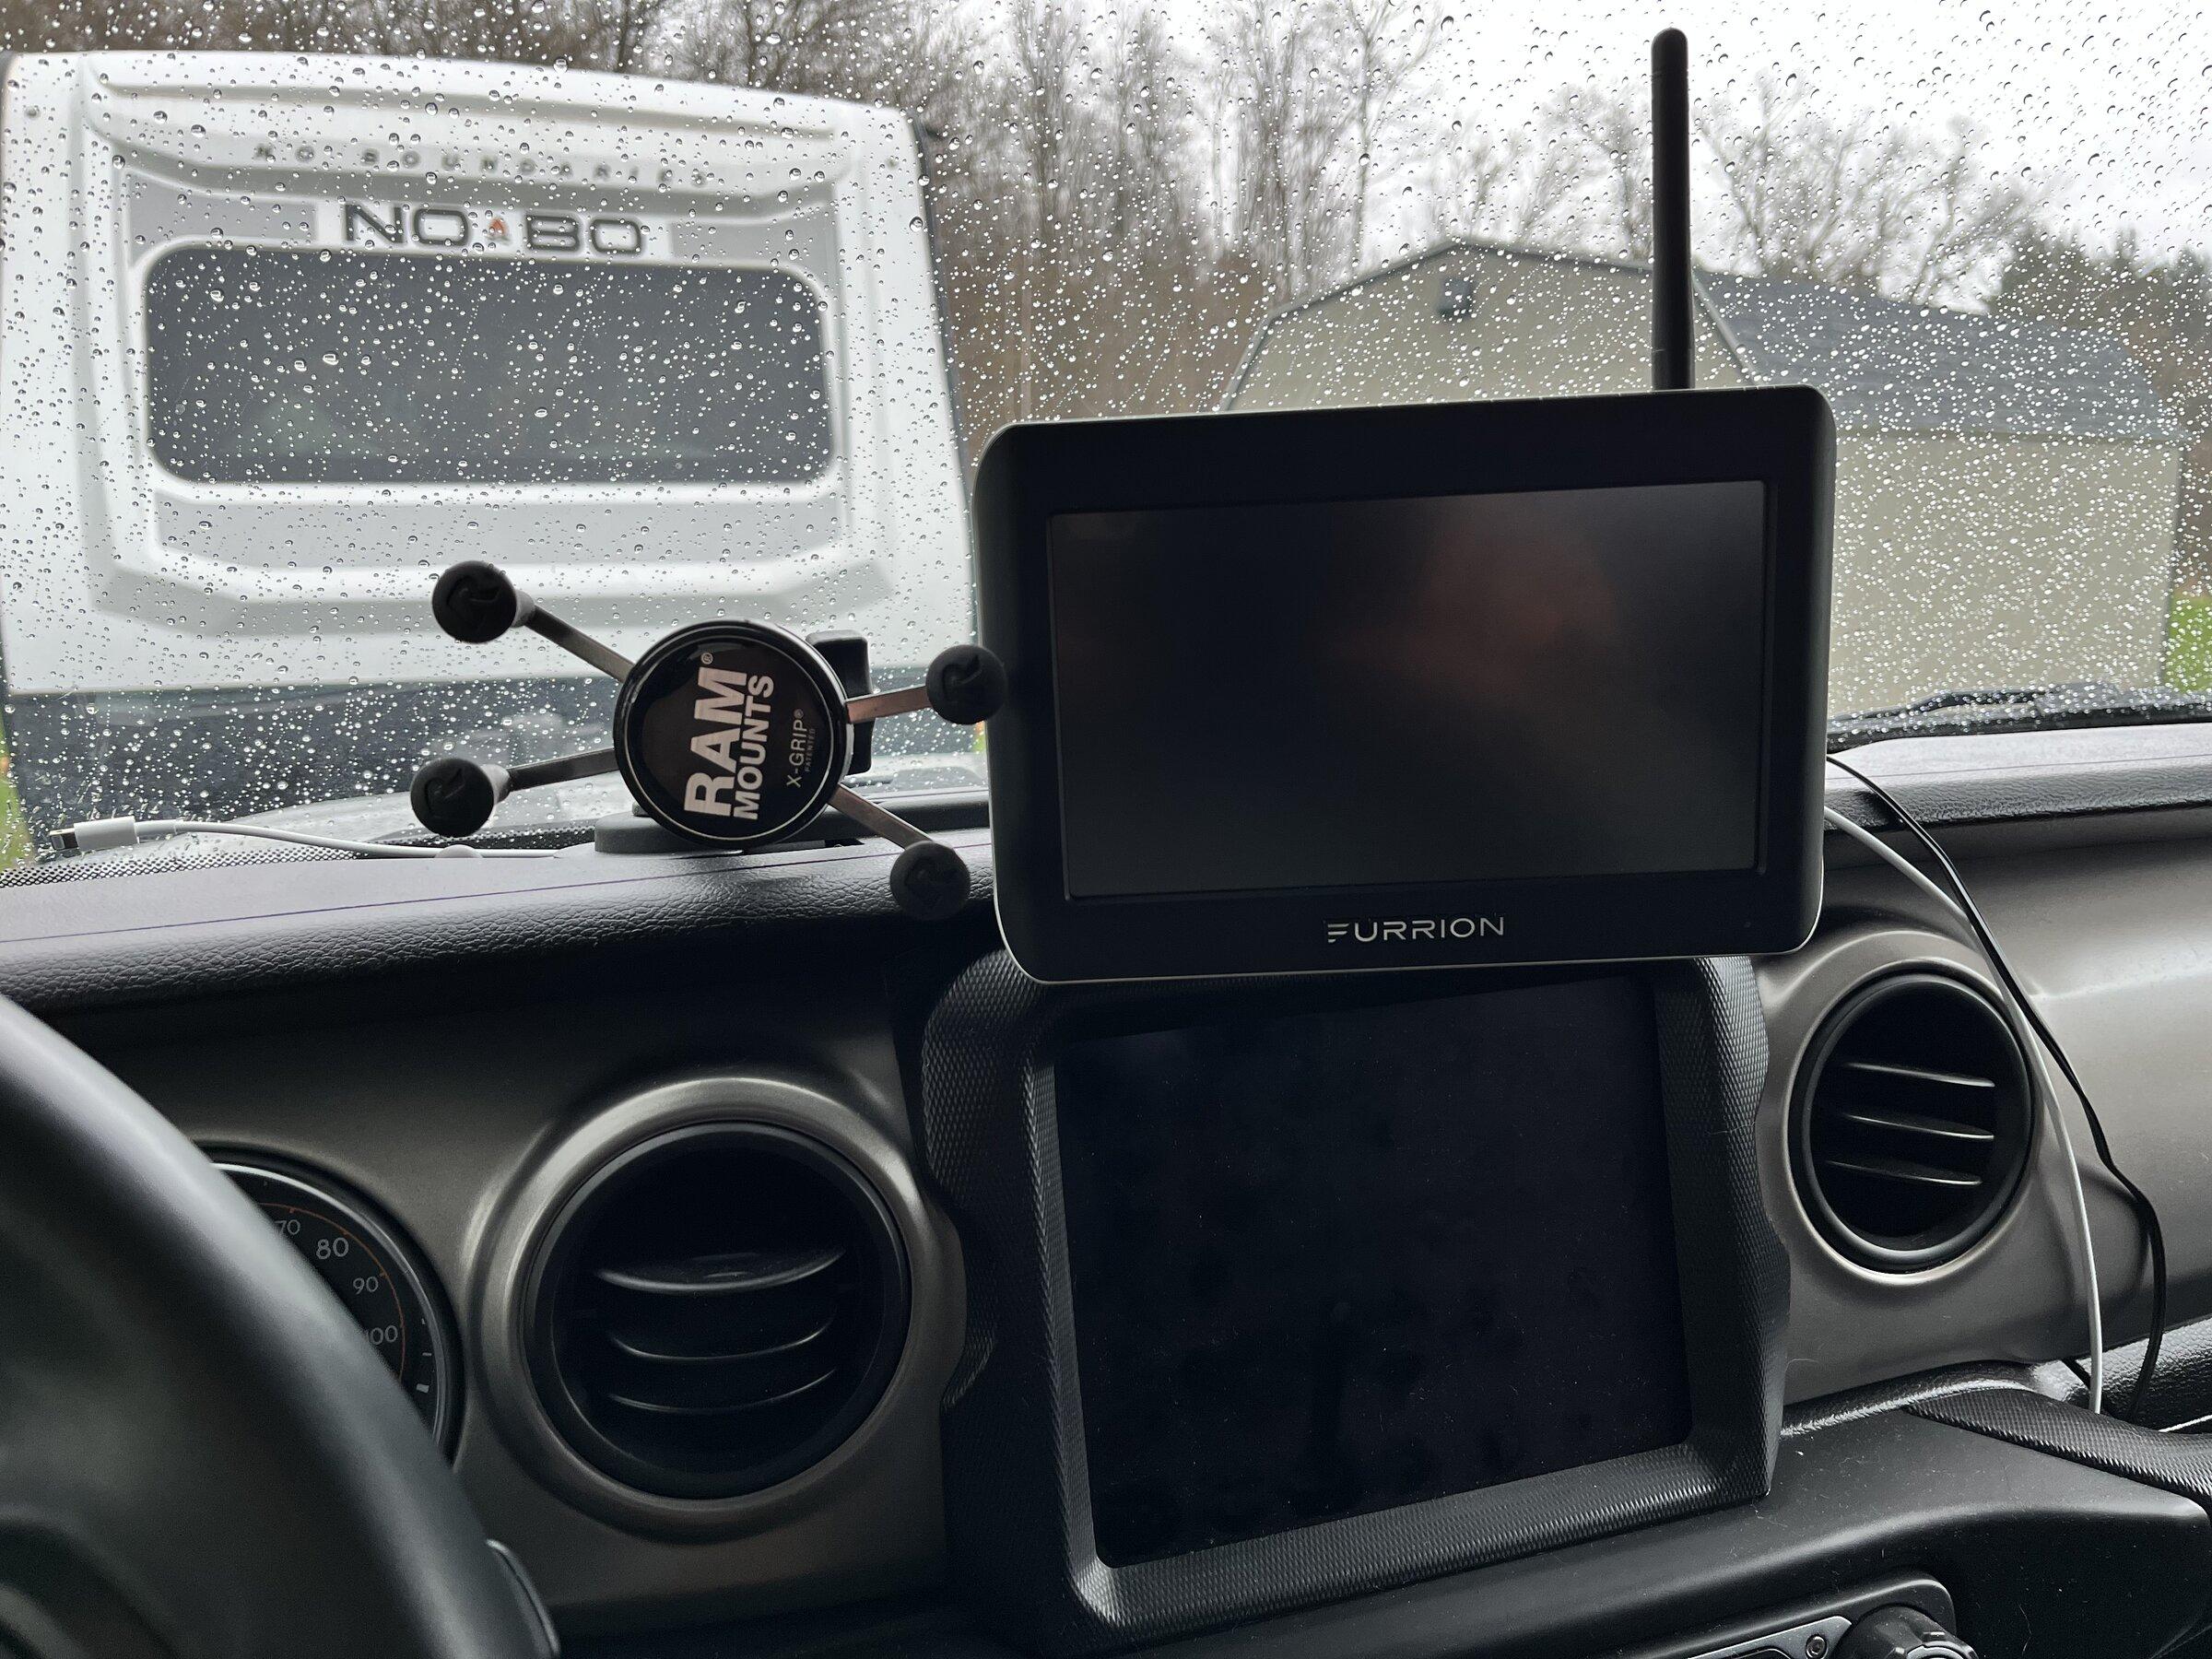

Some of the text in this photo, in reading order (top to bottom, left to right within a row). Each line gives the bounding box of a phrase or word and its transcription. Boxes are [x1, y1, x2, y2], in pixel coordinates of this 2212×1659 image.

[734, 675, 774, 820] MOUNTS
[1327, 916, 1504, 944] FURRION
[274, 1219, 300, 1235] 70
[316, 1237, 349, 1260] 80
[352, 1276, 379, 1295] 90
